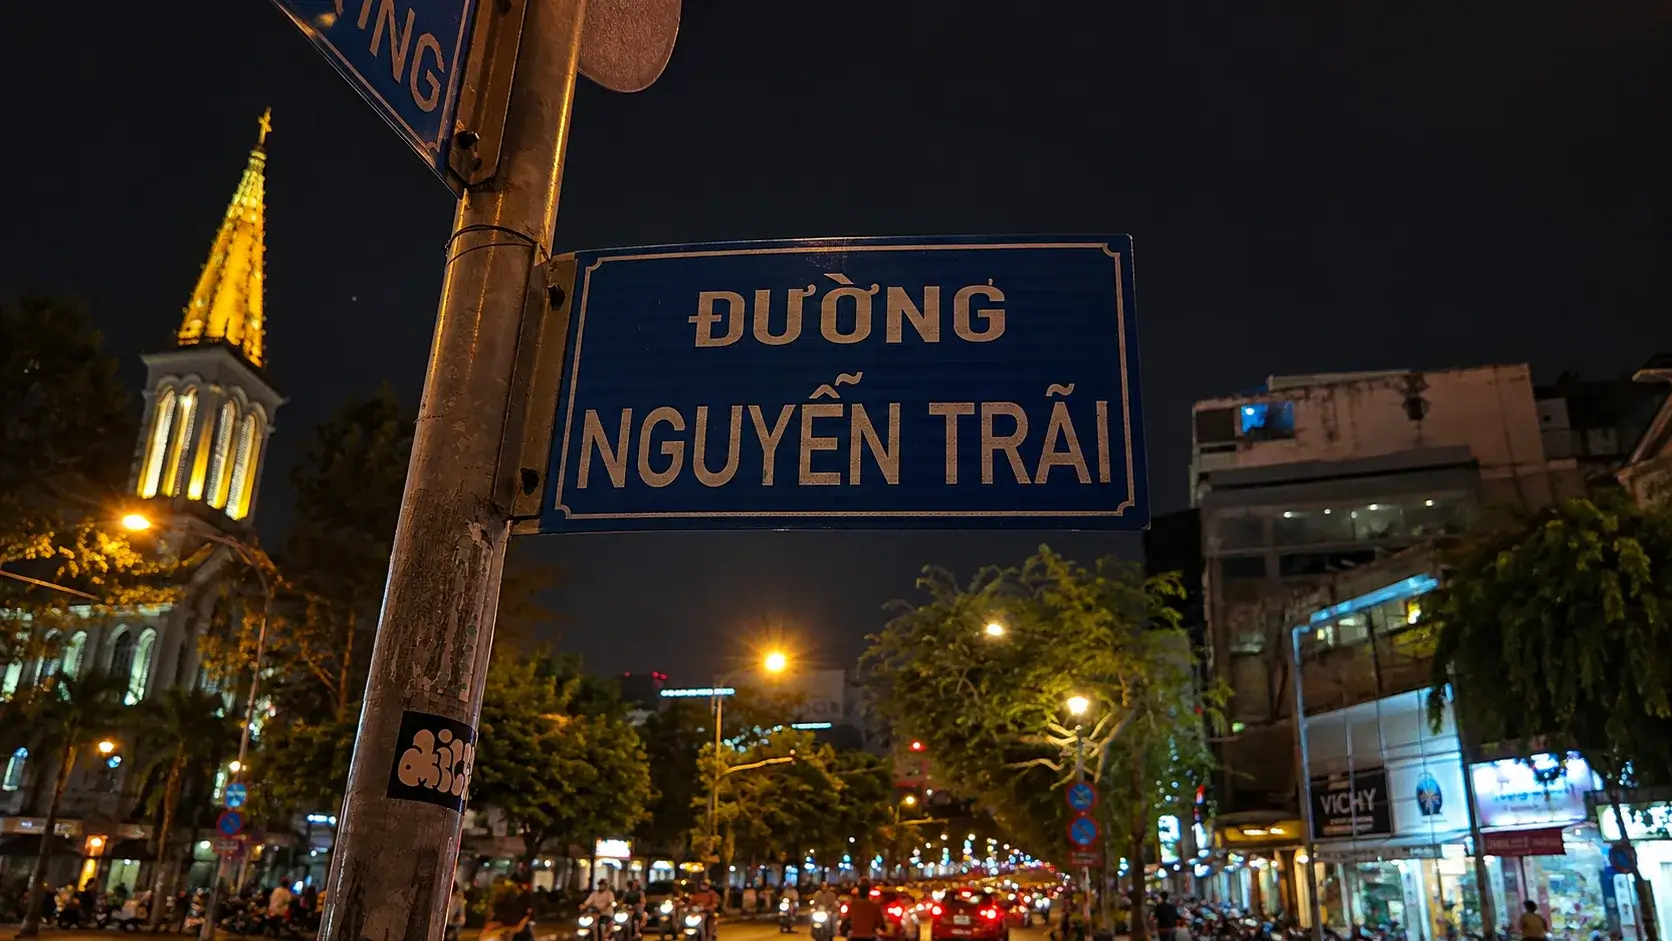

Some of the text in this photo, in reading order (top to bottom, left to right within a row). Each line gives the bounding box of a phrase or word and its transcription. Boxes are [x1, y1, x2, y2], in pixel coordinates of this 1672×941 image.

[688, 272, 1007, 348] ĐƯỜNG
[575, 371, 1111, 490] NGUYỄN TRÃI
[1319, 787, 1377, 815] VICHY
